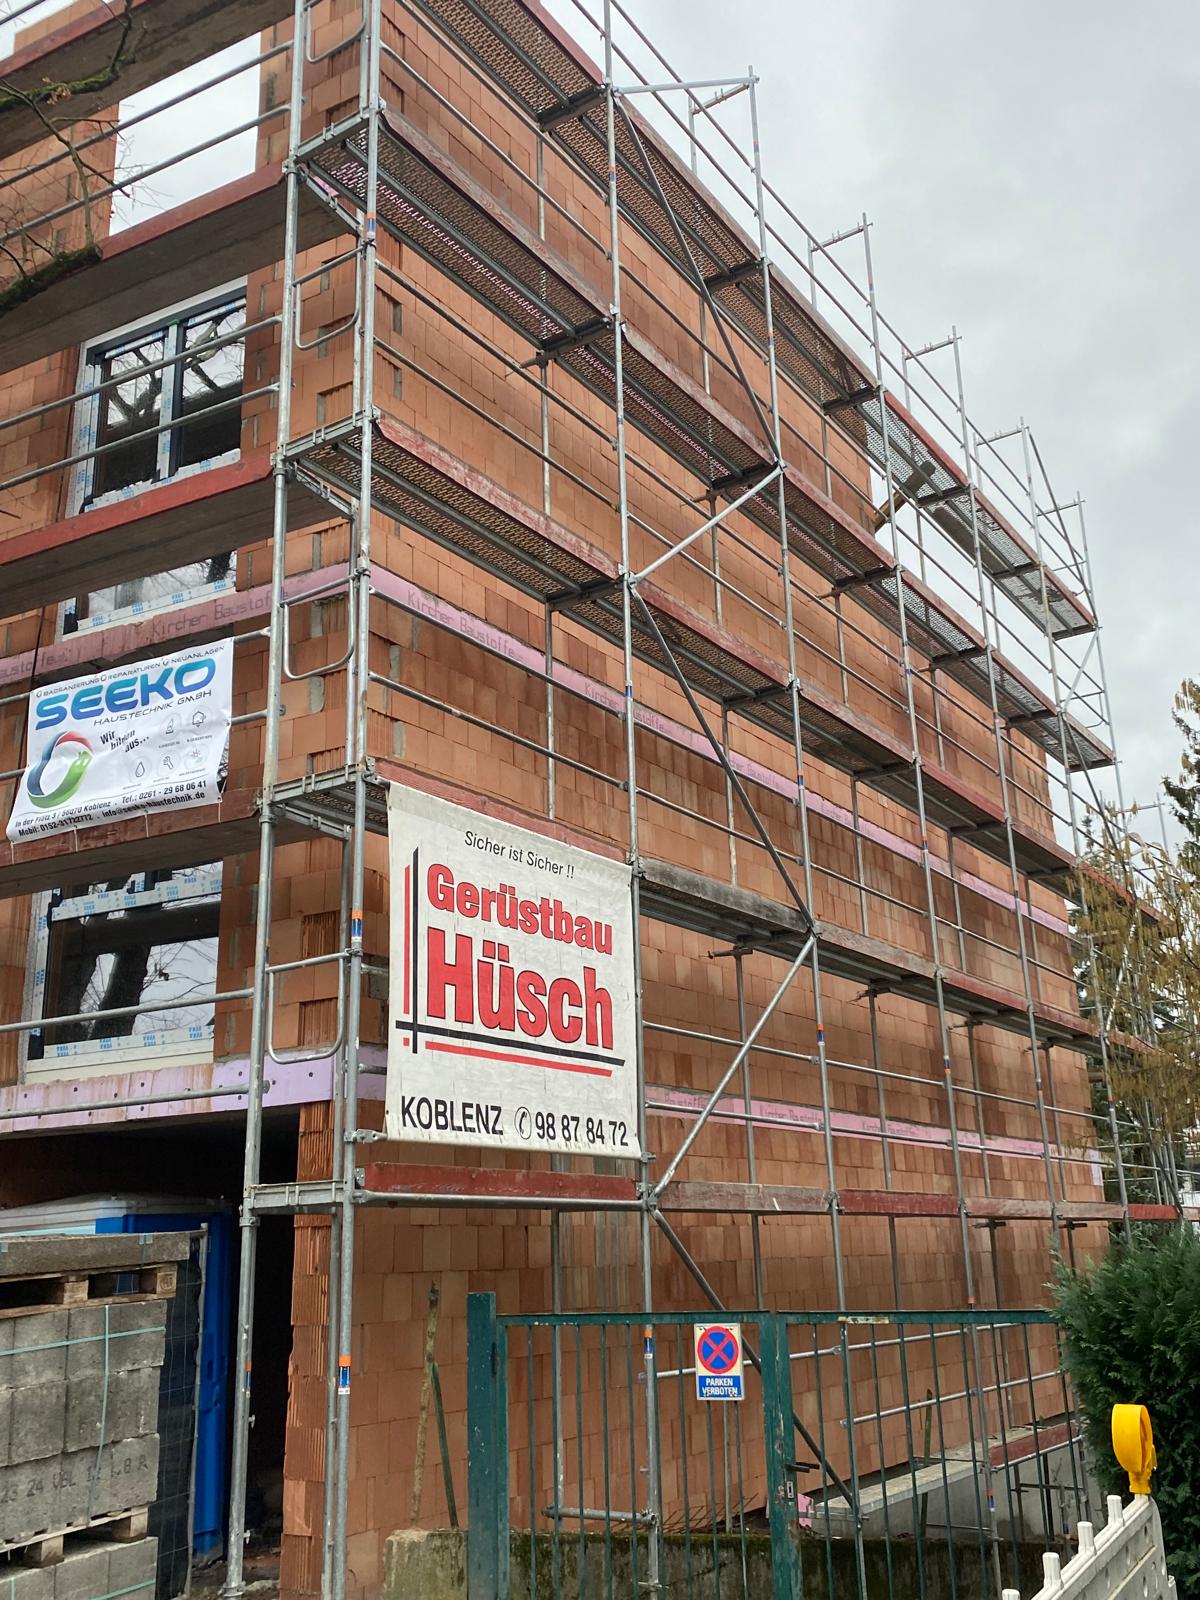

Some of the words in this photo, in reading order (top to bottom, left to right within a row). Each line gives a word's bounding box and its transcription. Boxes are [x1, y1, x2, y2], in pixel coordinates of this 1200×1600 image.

[171, 645, 225, 664] NEUANLAGEN
[35, 658, 216, 731] SEEKO
[93, 700, 174, 726] HAUSTECHNIK
[100, 730, 116, 745] Wir
[138, 790, 156, 801] 0261
[163, 786, 173, 795] 29
[186, 781, 196, 791] 06
[197, 780, 207, 789] 41
[83, 800, 112, 812] Koblenz
[18, 826, 40, 837] Mobil:
[464, 830, 506, 856] Sicher
[509, 845, 524, 863] ist
[526, 851, 564, 876] Sicher
[566, 864, 575, 879] !!
[427, 862, 613, 956] Gerüstbau
[427, 926, 614, 1051] Hüsch
[401, 1095, 504, 1136] KOBLENZ
[535, 1111, 557, 1141] 98
[561, 1114, 580, 1142] 87
[586, 1117, 605, 1145] 84
[608, 1120, 629, 1147] 72
[702, 1386, 739, 1396] VERBOTEN
[705, 1378, 734, 1387] PARKEN
